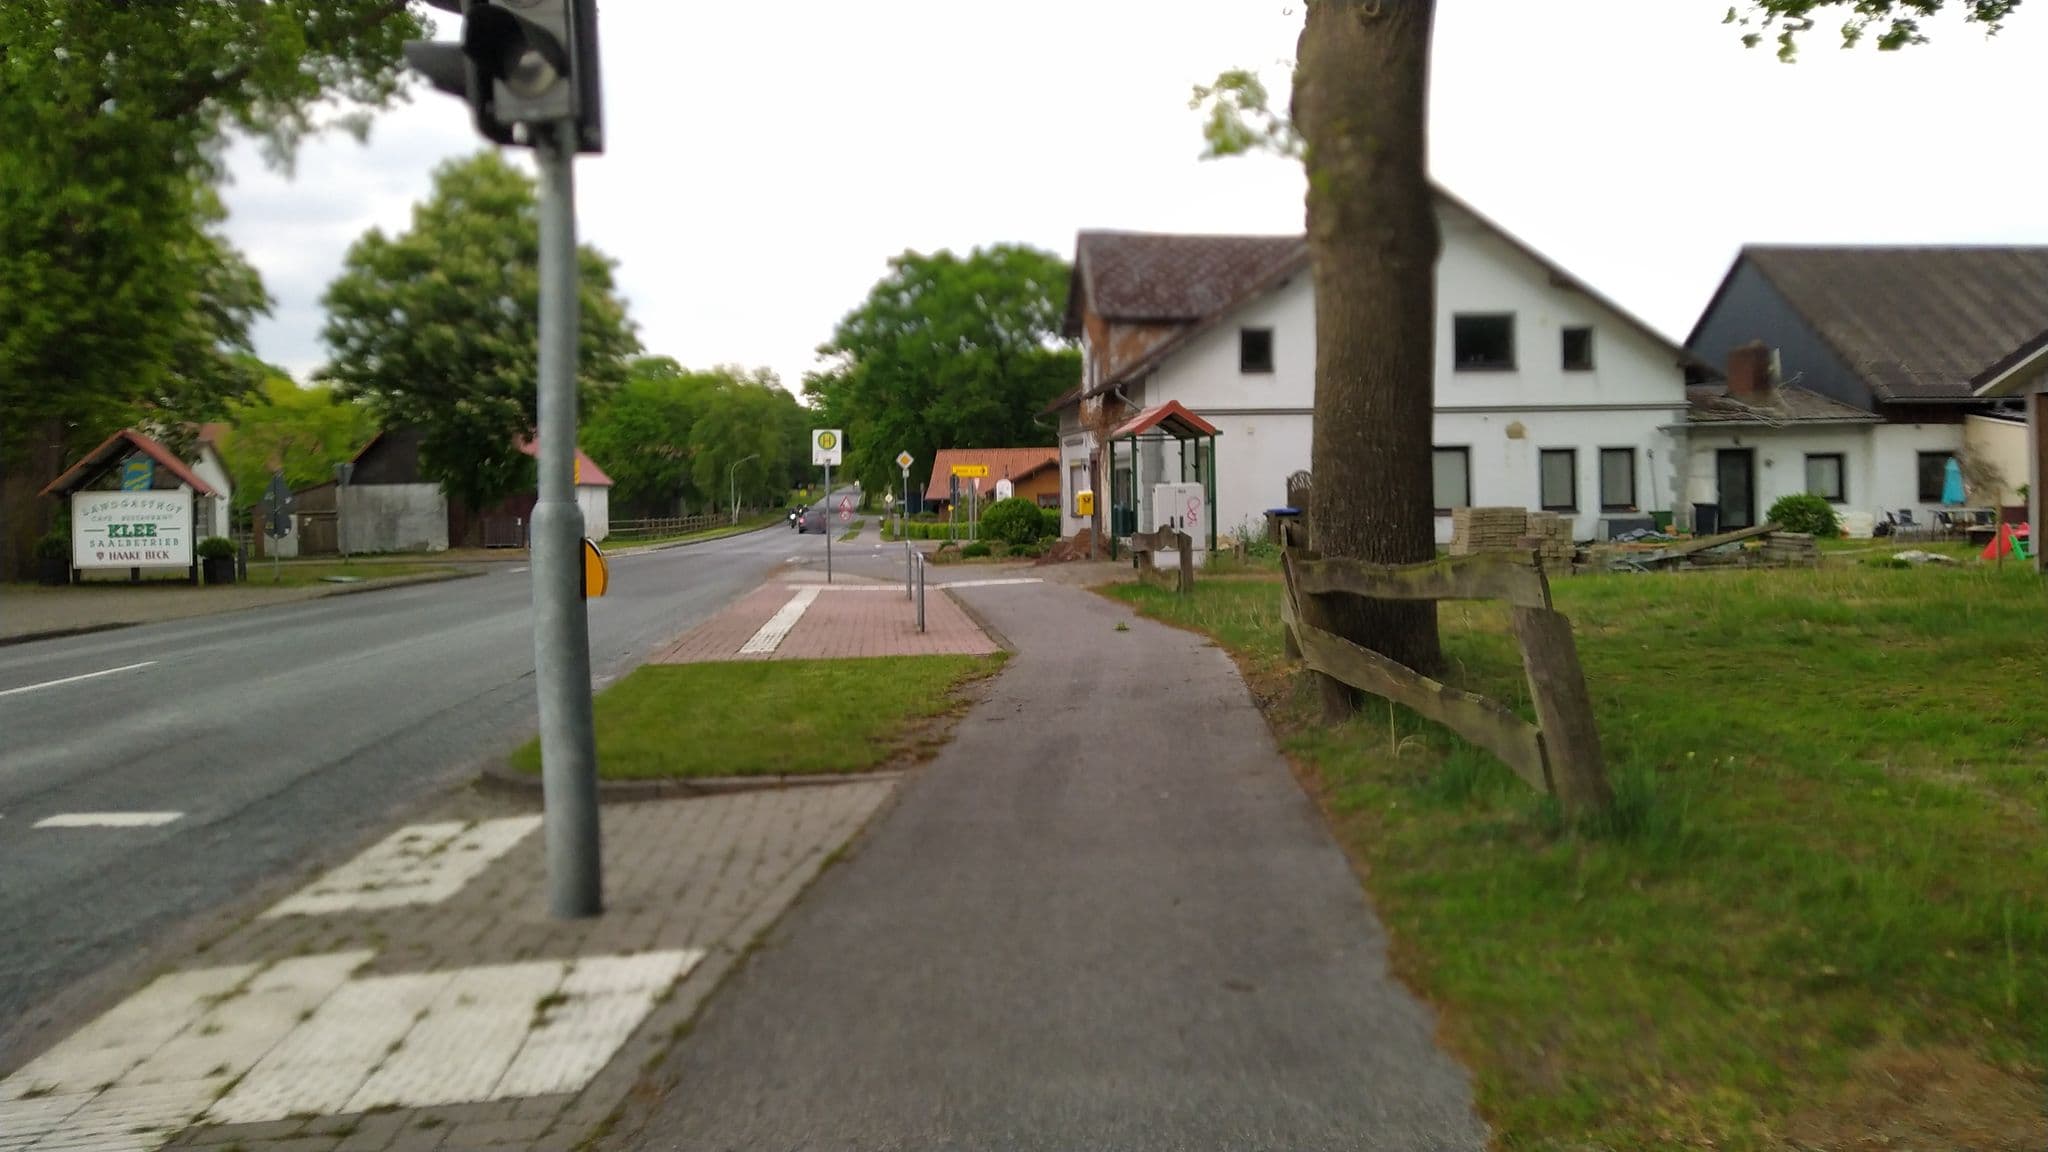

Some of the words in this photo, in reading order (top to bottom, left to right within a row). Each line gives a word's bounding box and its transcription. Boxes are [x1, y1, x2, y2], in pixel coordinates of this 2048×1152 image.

[107, 523, 158, 538] KLEE
[89, 538, 179, 549] SAALBETRIEB
[109, 551, 141, 561] HAAKE
[145, 551, 170, 560] BECK
